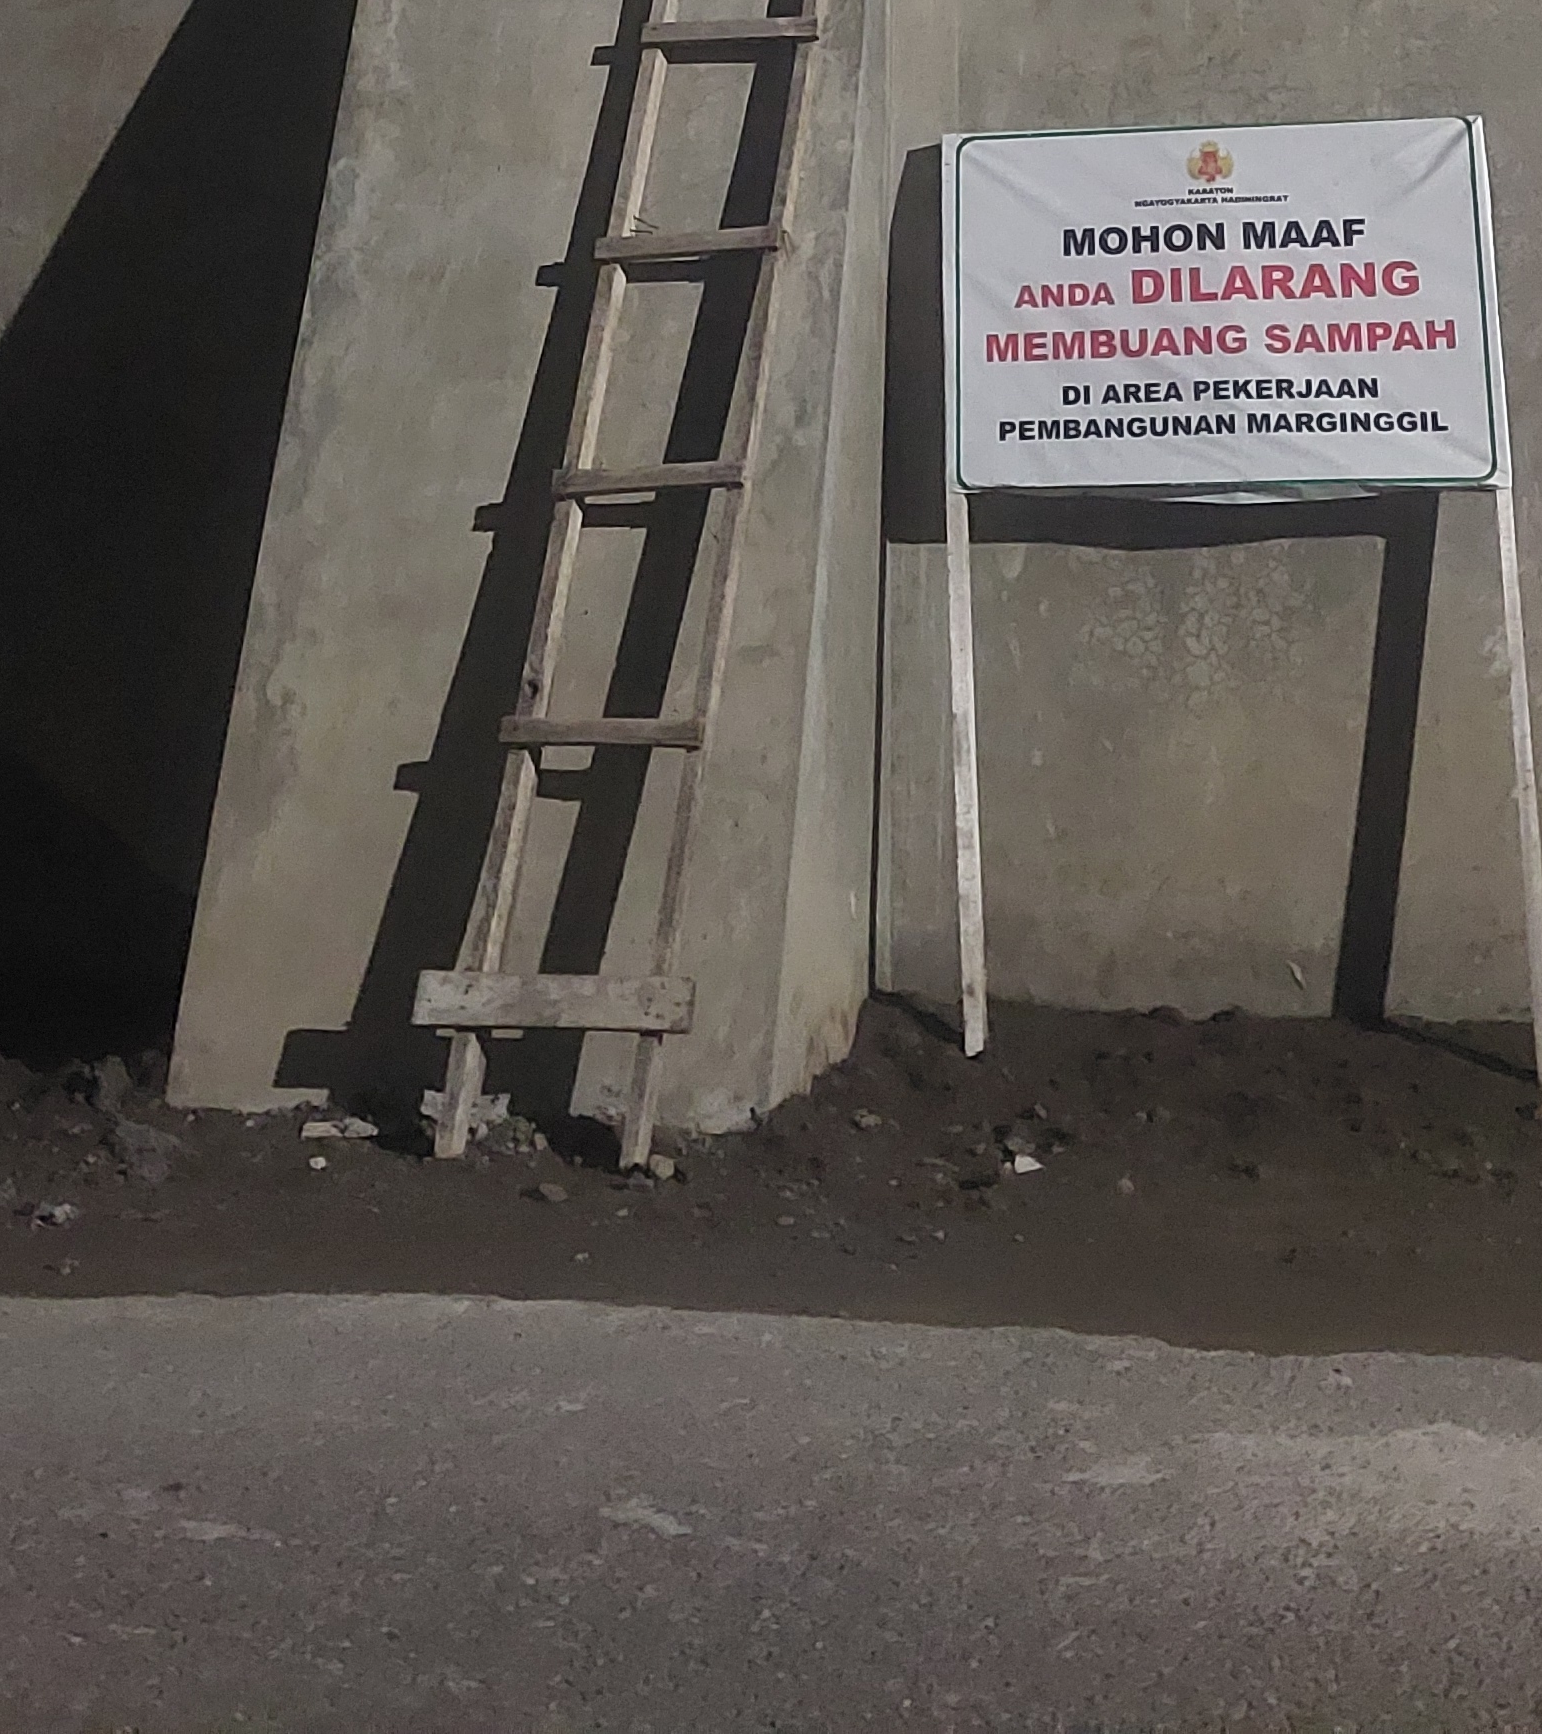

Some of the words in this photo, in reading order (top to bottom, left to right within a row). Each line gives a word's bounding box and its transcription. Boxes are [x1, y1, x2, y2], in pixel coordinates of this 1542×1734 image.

[1063, 222, 1226, 257] MOHON
[1242, 218, 1366, 250] MAAF
[1014, 282, 1115, 309] ANDA
[1131, 260, 1420, 305] DILARANG
[986, 324, 1247, 363] MEMBUANG
[1264, 319, 1457, 354] SAMPAH
[1062, 384, 1091, 406] DI
[1100, 381, 1184, 405] AREA
[1193, 377, 1379, 402] PEKERJAAN
[999, 413, 1236, 442] PEMBANGUNAN
[1246, 410, 1449, 434] MARGINGGIL
